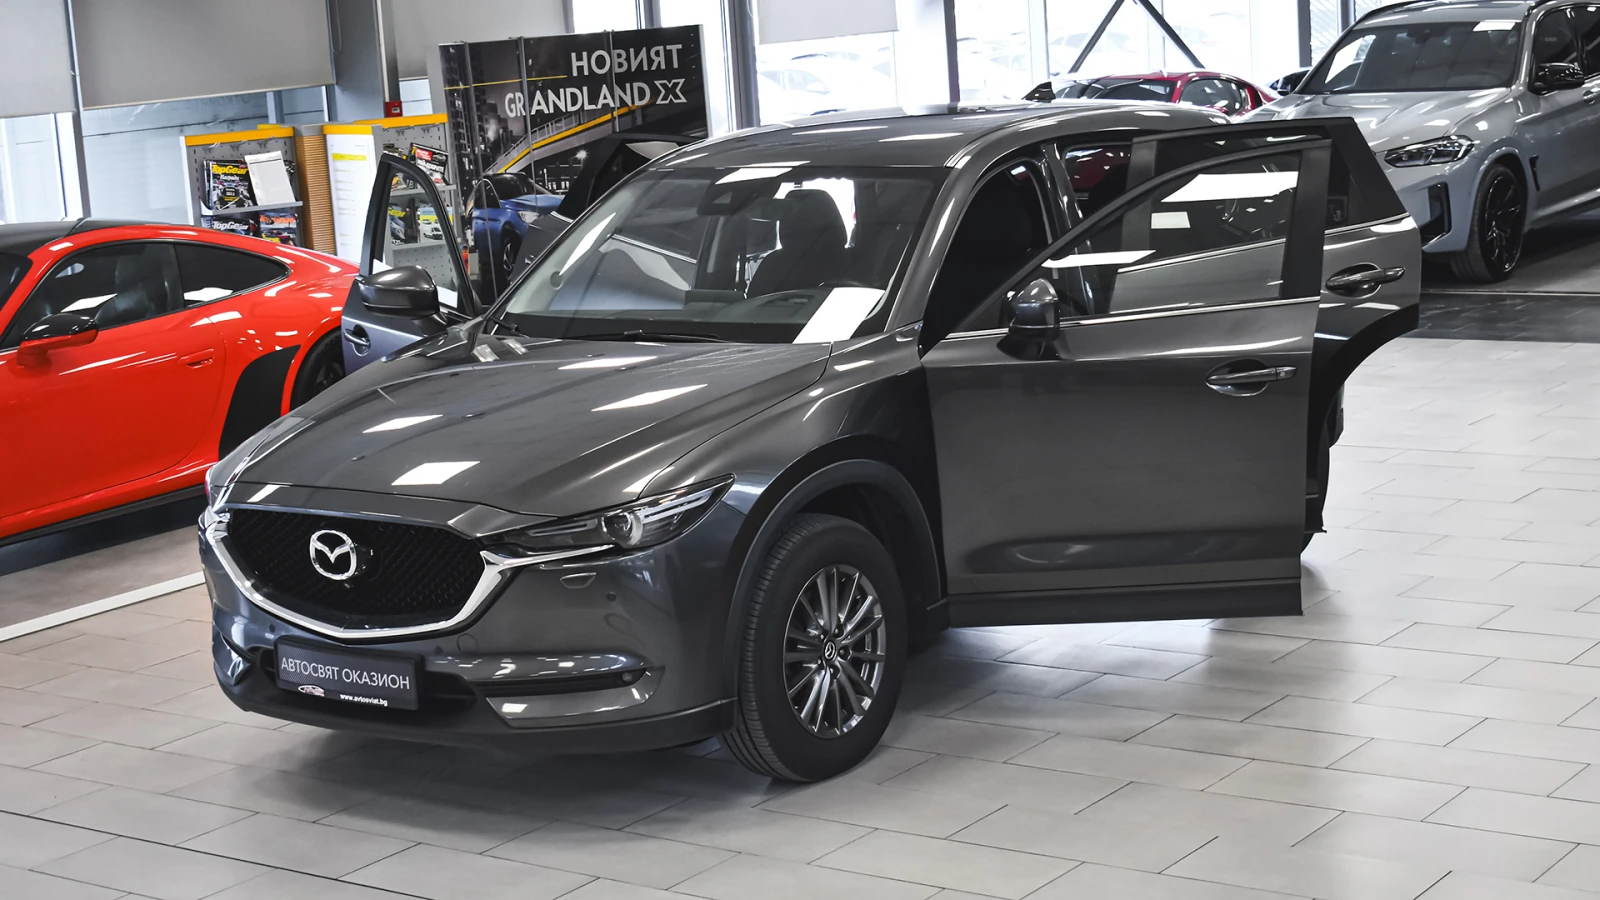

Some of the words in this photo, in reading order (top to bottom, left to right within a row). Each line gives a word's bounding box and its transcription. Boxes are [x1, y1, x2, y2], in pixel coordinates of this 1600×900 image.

[571, 44, 683, 77] НОВИЯТ
[504, 82, 651, 118] GRANDLAND
[654, 78, 688, 105] X
[211, 164, 248, 175] TopGear
[212, 221, 249, 230] TopGear
[281, 657, 339, 680] АВТОСВЯТ
[342, 668, 410, 690] ОКАЗИОН
